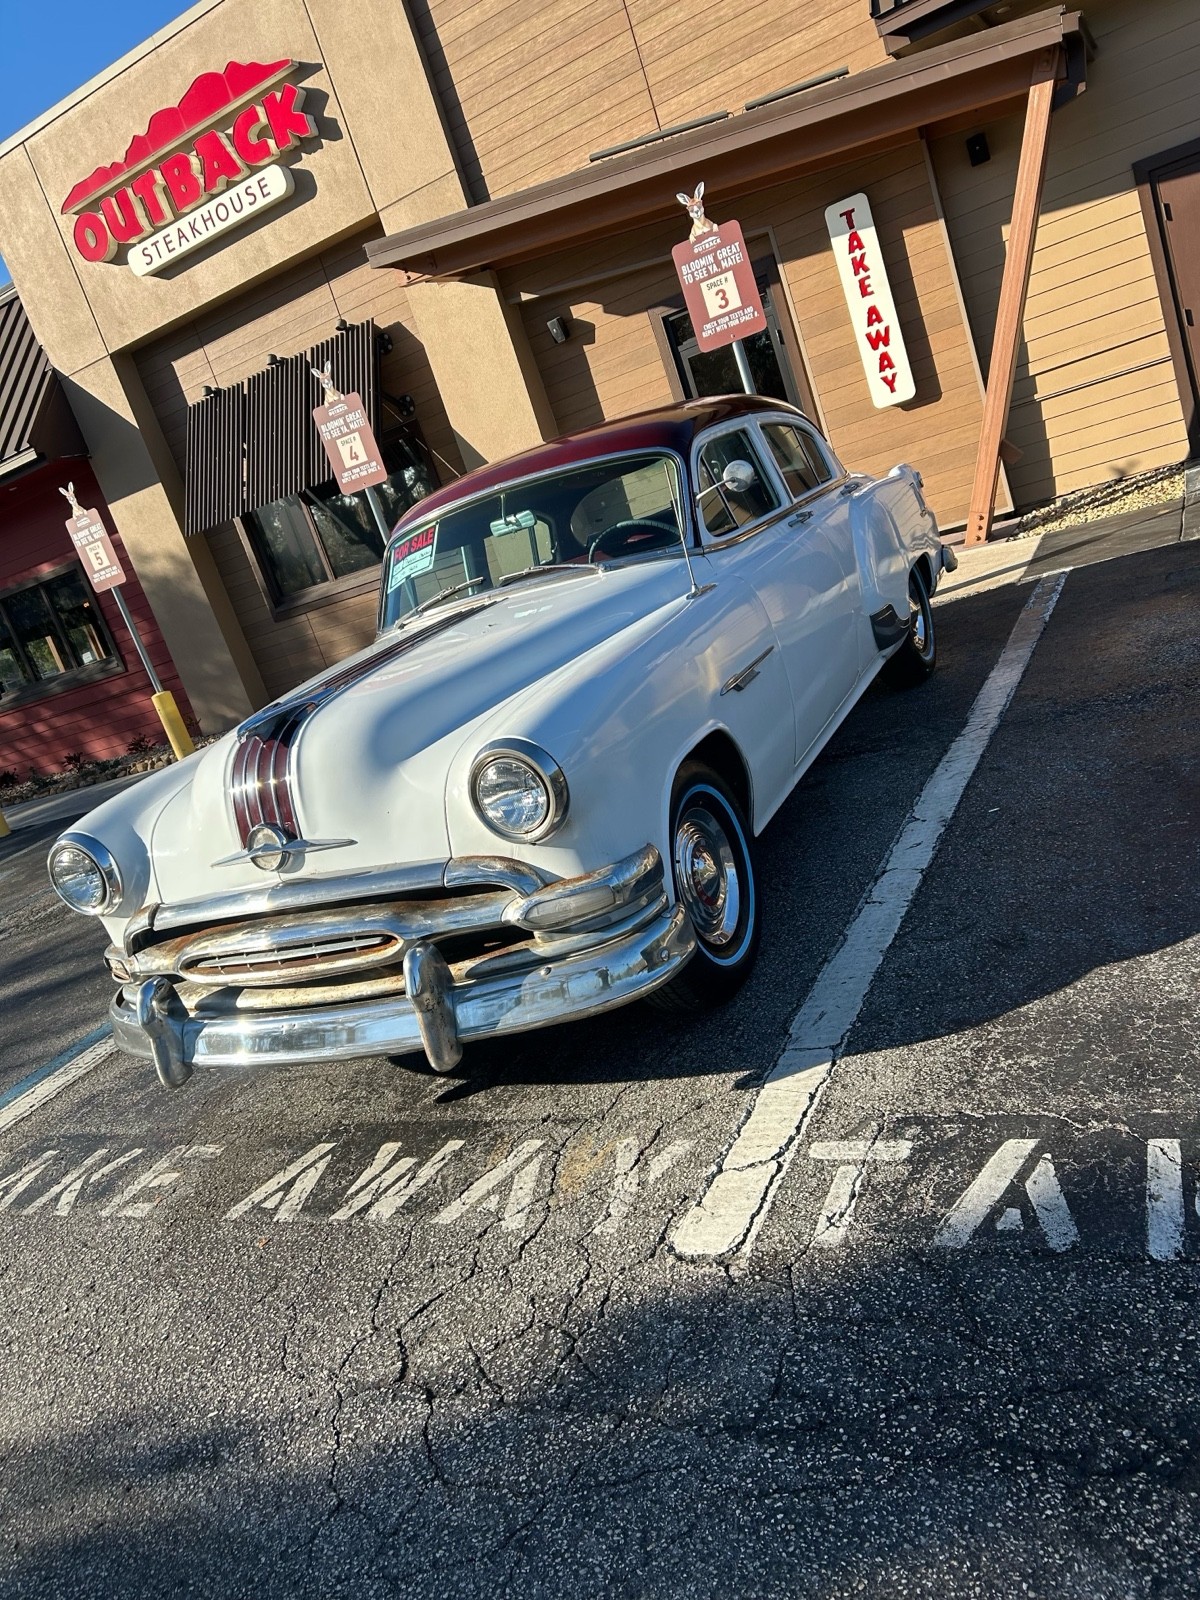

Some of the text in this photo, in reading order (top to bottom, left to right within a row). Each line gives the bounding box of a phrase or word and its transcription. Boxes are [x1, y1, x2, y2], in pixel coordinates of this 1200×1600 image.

[73, 83, 312, 262] OUTBACK
[141, 176, 272, 266] STEAKHOUSE
[693, 238, 721, 253] OUTBACK
[681, 242, 740, 275] BLOOMIN' GREAT
[683, 252, 743, 284] TO SEE YA, MATE!
[706, 277, 723, 291] SPACE
[714, 288, 729, 309] 3
[839, 207, 898, 393] TAKE AWAY
[744, 305, 754, 316] AND
[345, 409, 362, 423] GREAT
[323, 431, 331, 441] TO
[331, 427, 341, 438] SEE
[349, 446, 359, 461] 4
[395, 527, 435, 563] FOR SALE
[94, 552, 104, 566] 5
